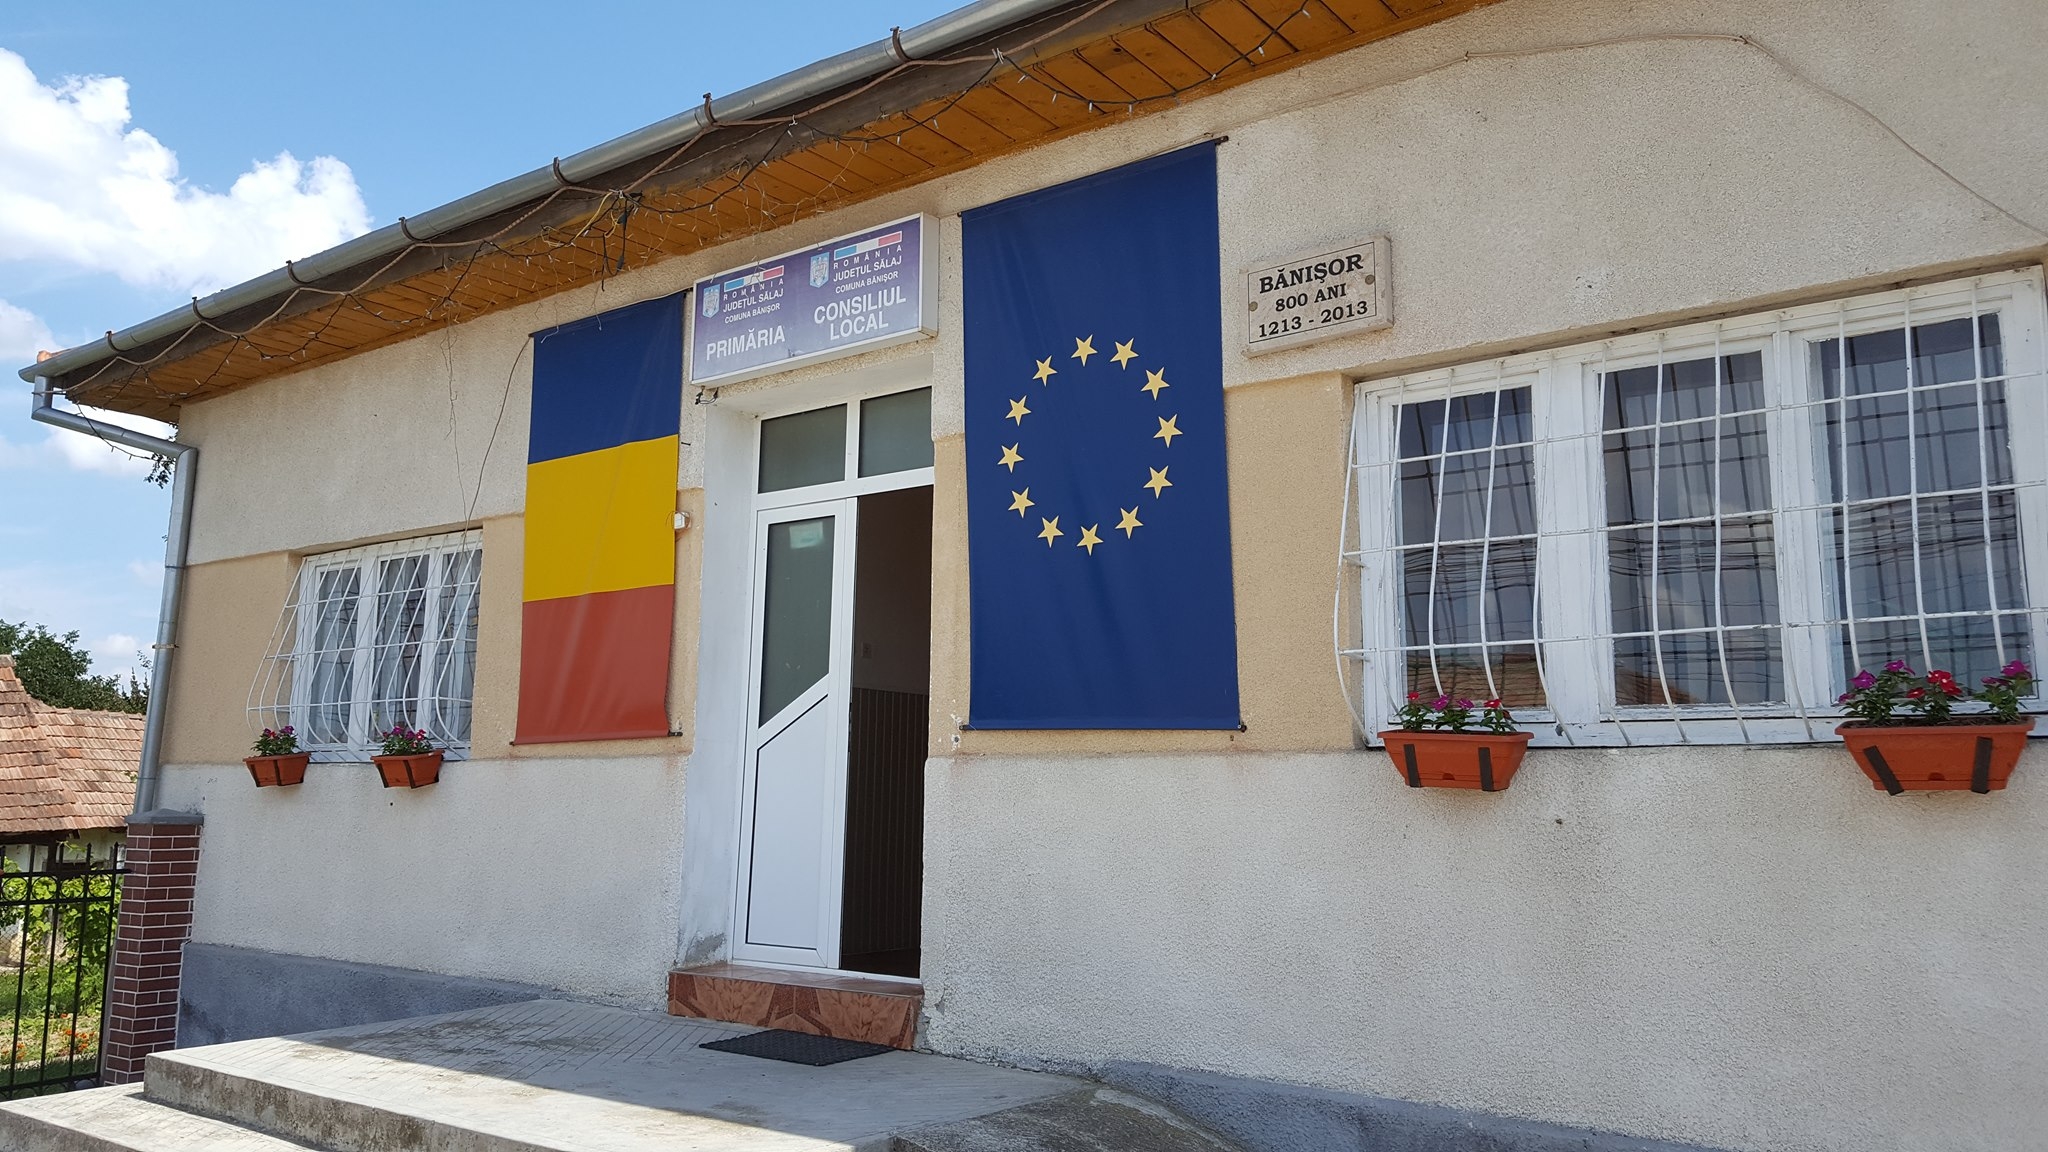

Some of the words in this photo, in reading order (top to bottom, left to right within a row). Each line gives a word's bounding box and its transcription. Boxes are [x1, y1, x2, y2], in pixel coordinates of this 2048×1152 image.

[873, 255, 902, 271] SĂLAJ
[758, 288, 784, 303] SĂLAJ
[835, 279, 866, 294] COMUNA
[1275, 292, 1308, 312] 800
[1314, 283, 1347, 303] ANI
[724, 311, 752, 324] COMUNA
[813, 285, 907, 324] CONSILIUL
[1258, 316, 1302, 338] 1213
[1320, 300, 1368, 324] 2013
[830, 310, 889, 341] LOCAL
[705, 324, 786, 361] PRIMĂRIA
